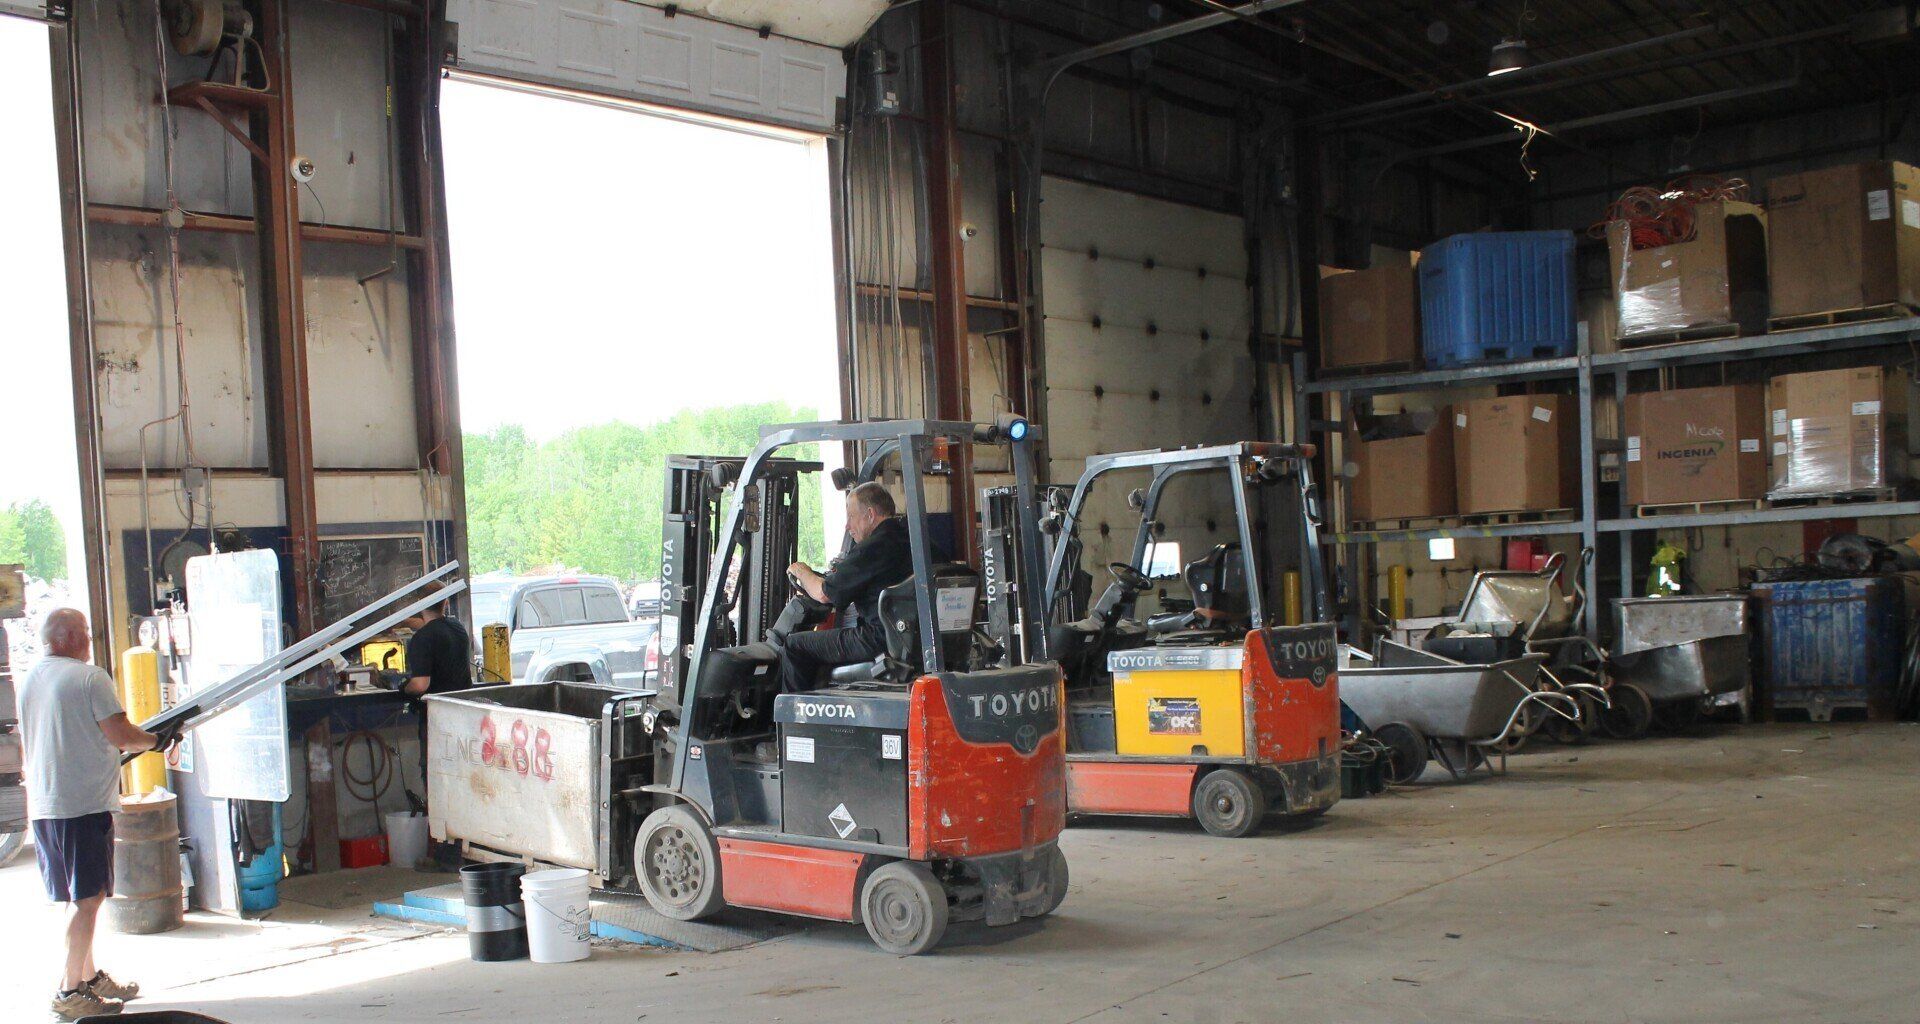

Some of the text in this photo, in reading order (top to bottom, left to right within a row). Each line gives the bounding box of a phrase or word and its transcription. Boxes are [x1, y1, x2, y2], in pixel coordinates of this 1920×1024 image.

[1657, 447, 1717, 460] INGENIA
[661, 538, 675, 613] TOYOTA
[984, 547, 997, 604] TOYOTA
[1112, 655, 1163, 668] TOYOTA
[797, 702, 856, 718] TOYOTA
[968, 686, 1058, 718] TOYOTA
[884, 739, 899, 755] 36V
